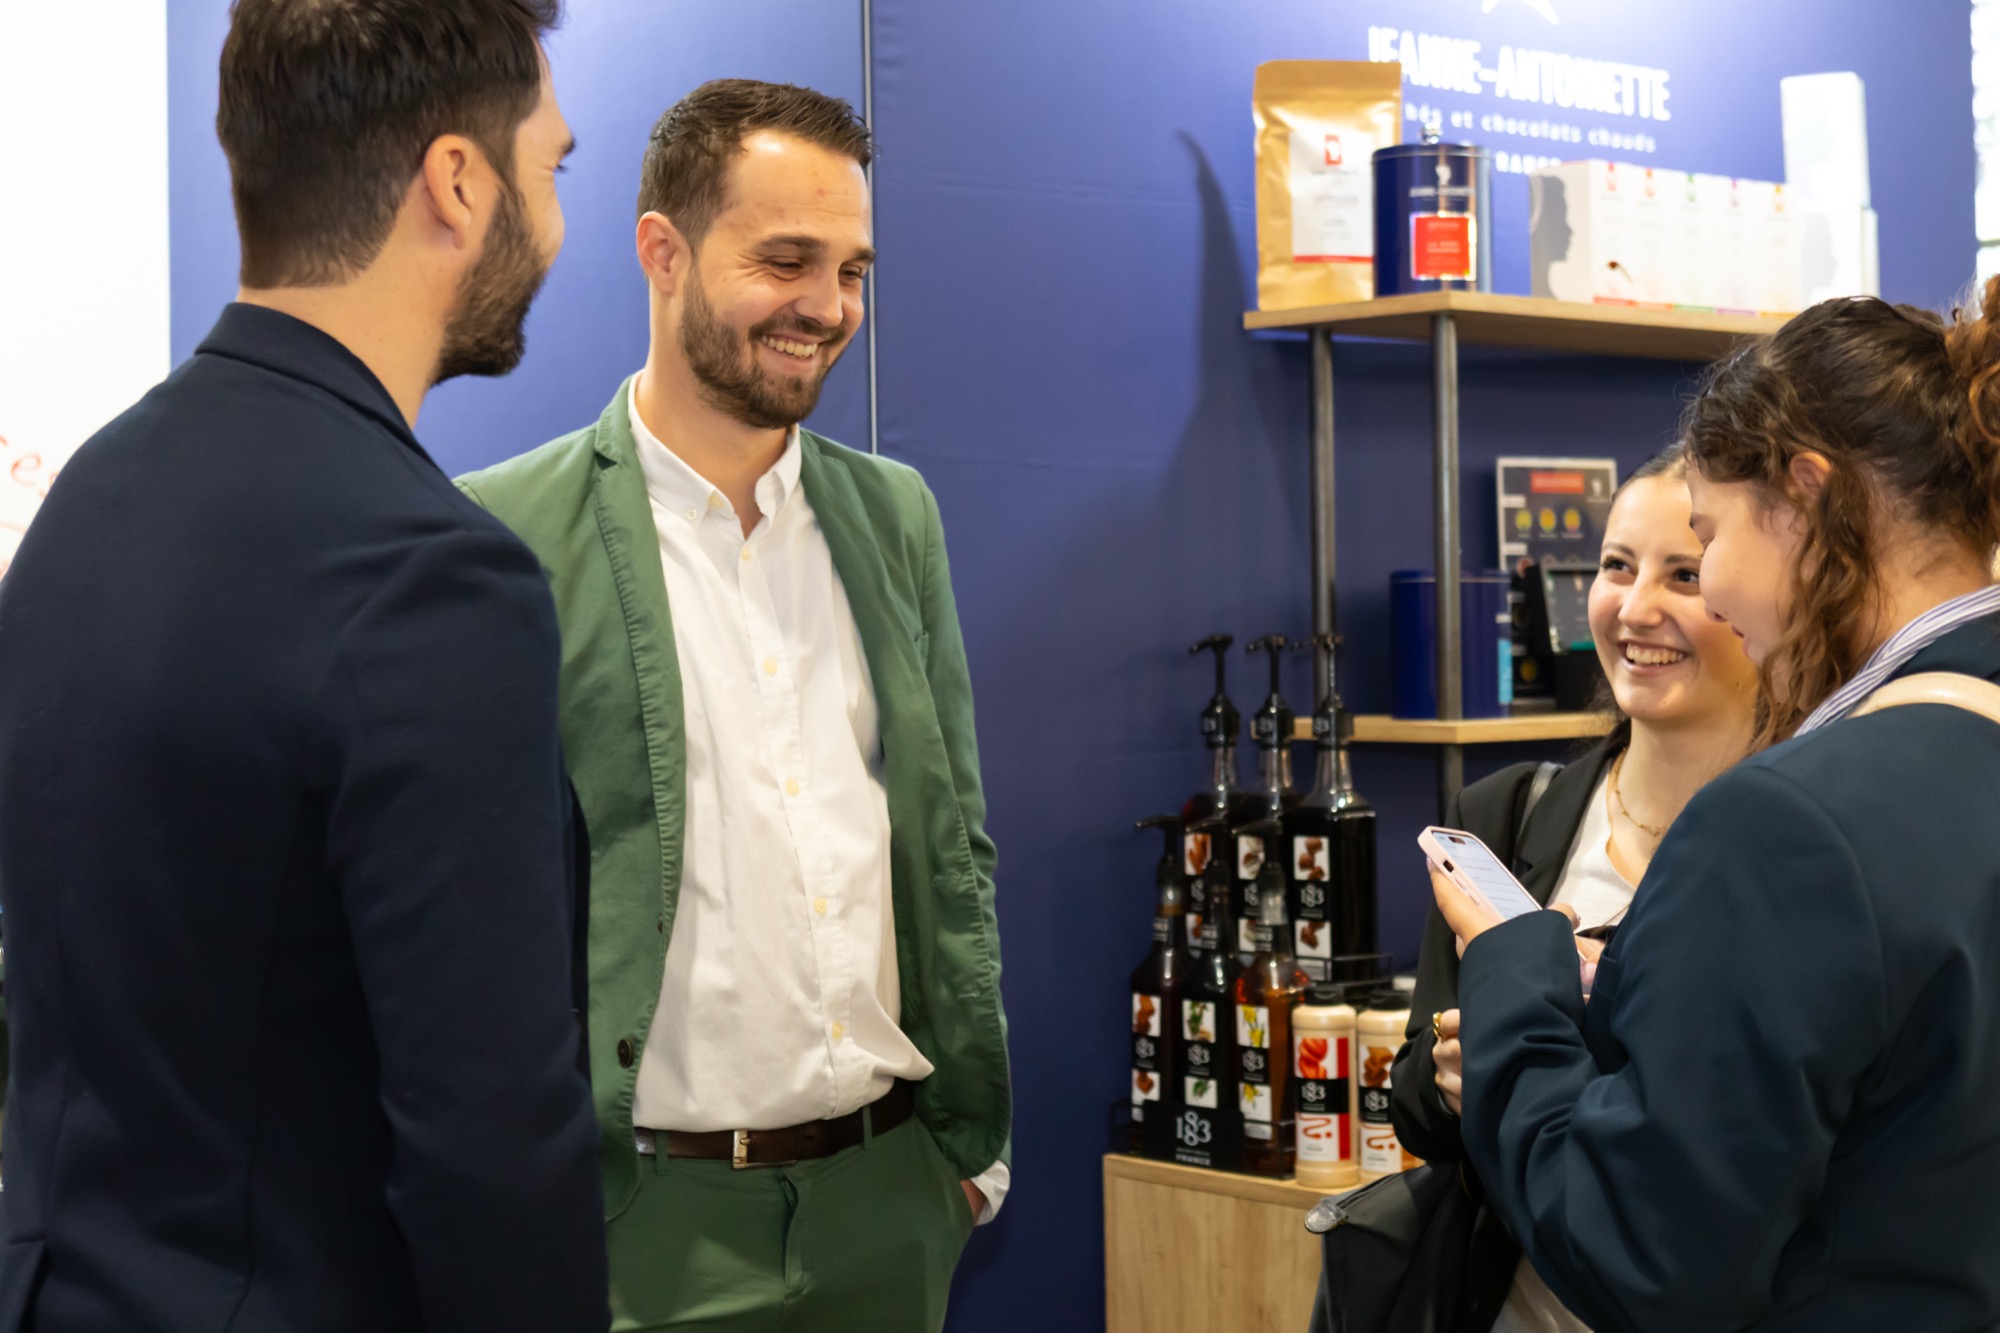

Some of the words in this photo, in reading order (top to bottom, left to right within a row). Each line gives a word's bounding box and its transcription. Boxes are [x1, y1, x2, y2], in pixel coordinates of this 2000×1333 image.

[1451, 110, 1474, 130] et
[1481, 111, 1582, 144] chocolats
[1588, 126, 1656, 153] chauds
